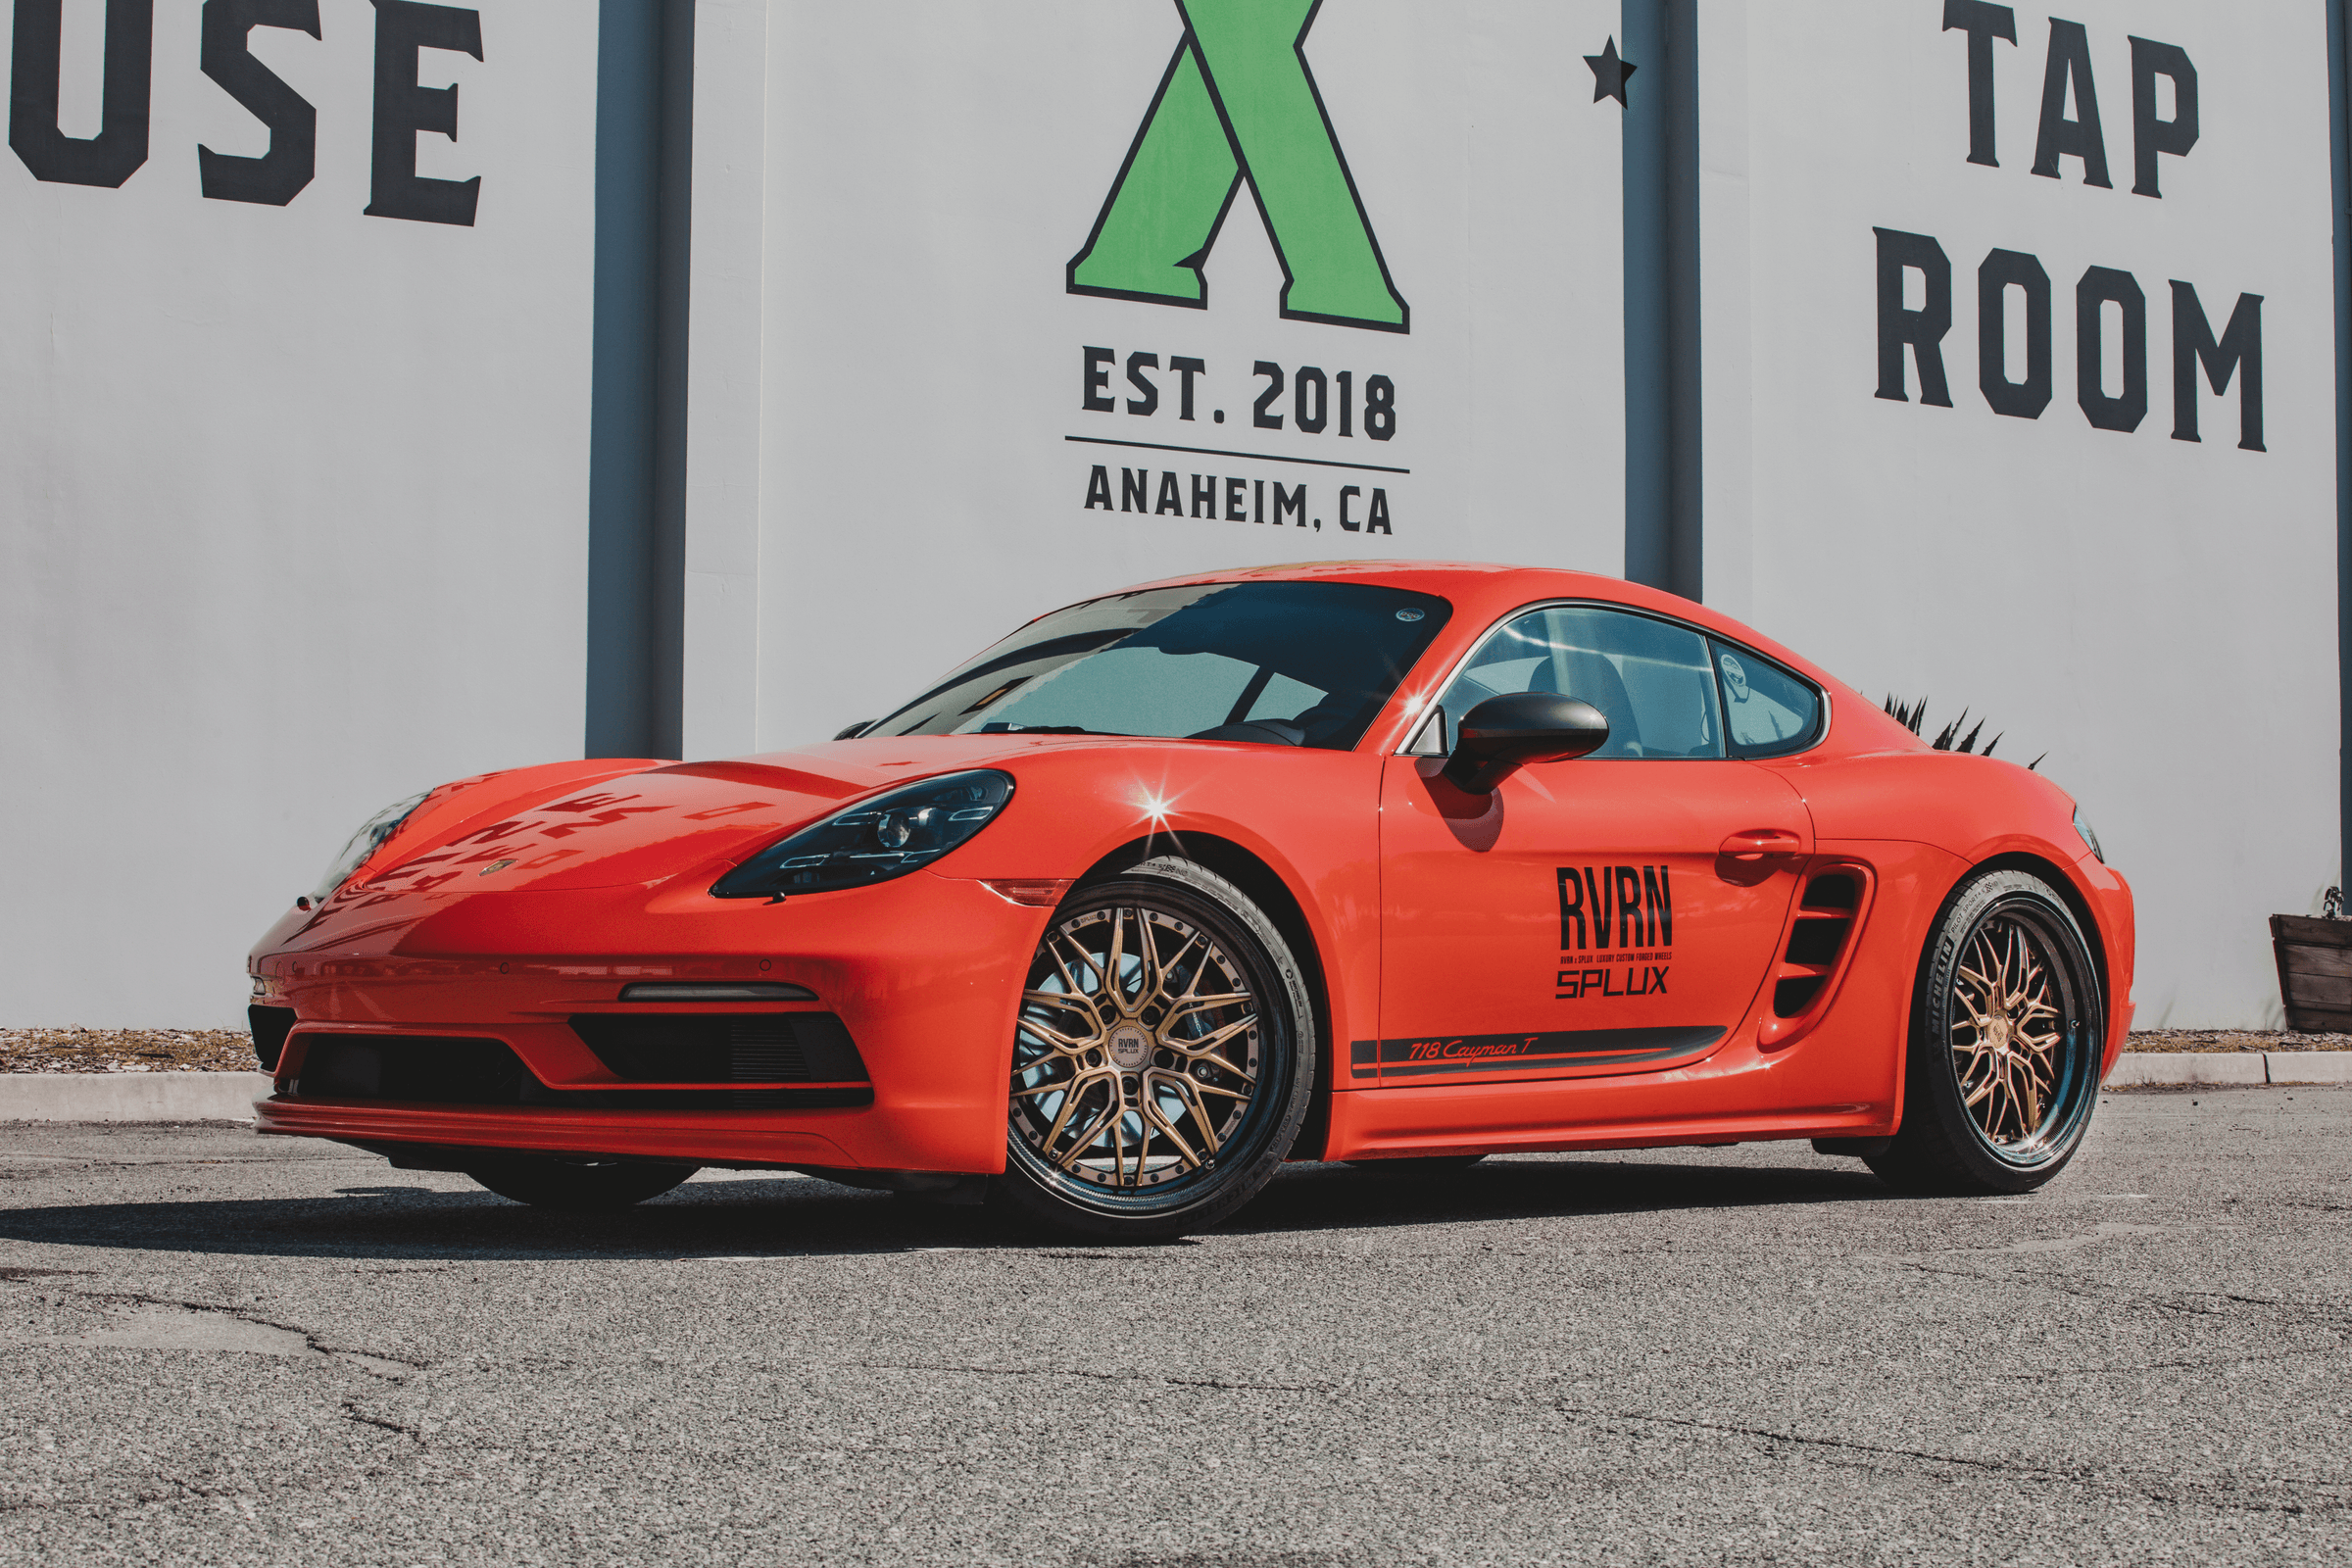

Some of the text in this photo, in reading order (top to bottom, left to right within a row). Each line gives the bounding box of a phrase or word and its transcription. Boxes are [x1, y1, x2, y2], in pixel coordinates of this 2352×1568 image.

[1942, 0, 2199, 199] TAP
[1873, 226, 2267, 453] ROOM
[1082, 346, 1396, 442] EST. 2018
[1084, 465, 1393, 535] ANAHEIM, CA
[1556, 865, 1673, 950] RVRN
[1555, 966, 1669, 999] SPLUX
[1931, 941, 1953, 1034] MICHELIN
[1118, 1038, 1139, 1048] RVRN
[1409, 1037, 1539, 1067] 718 Cayman T
